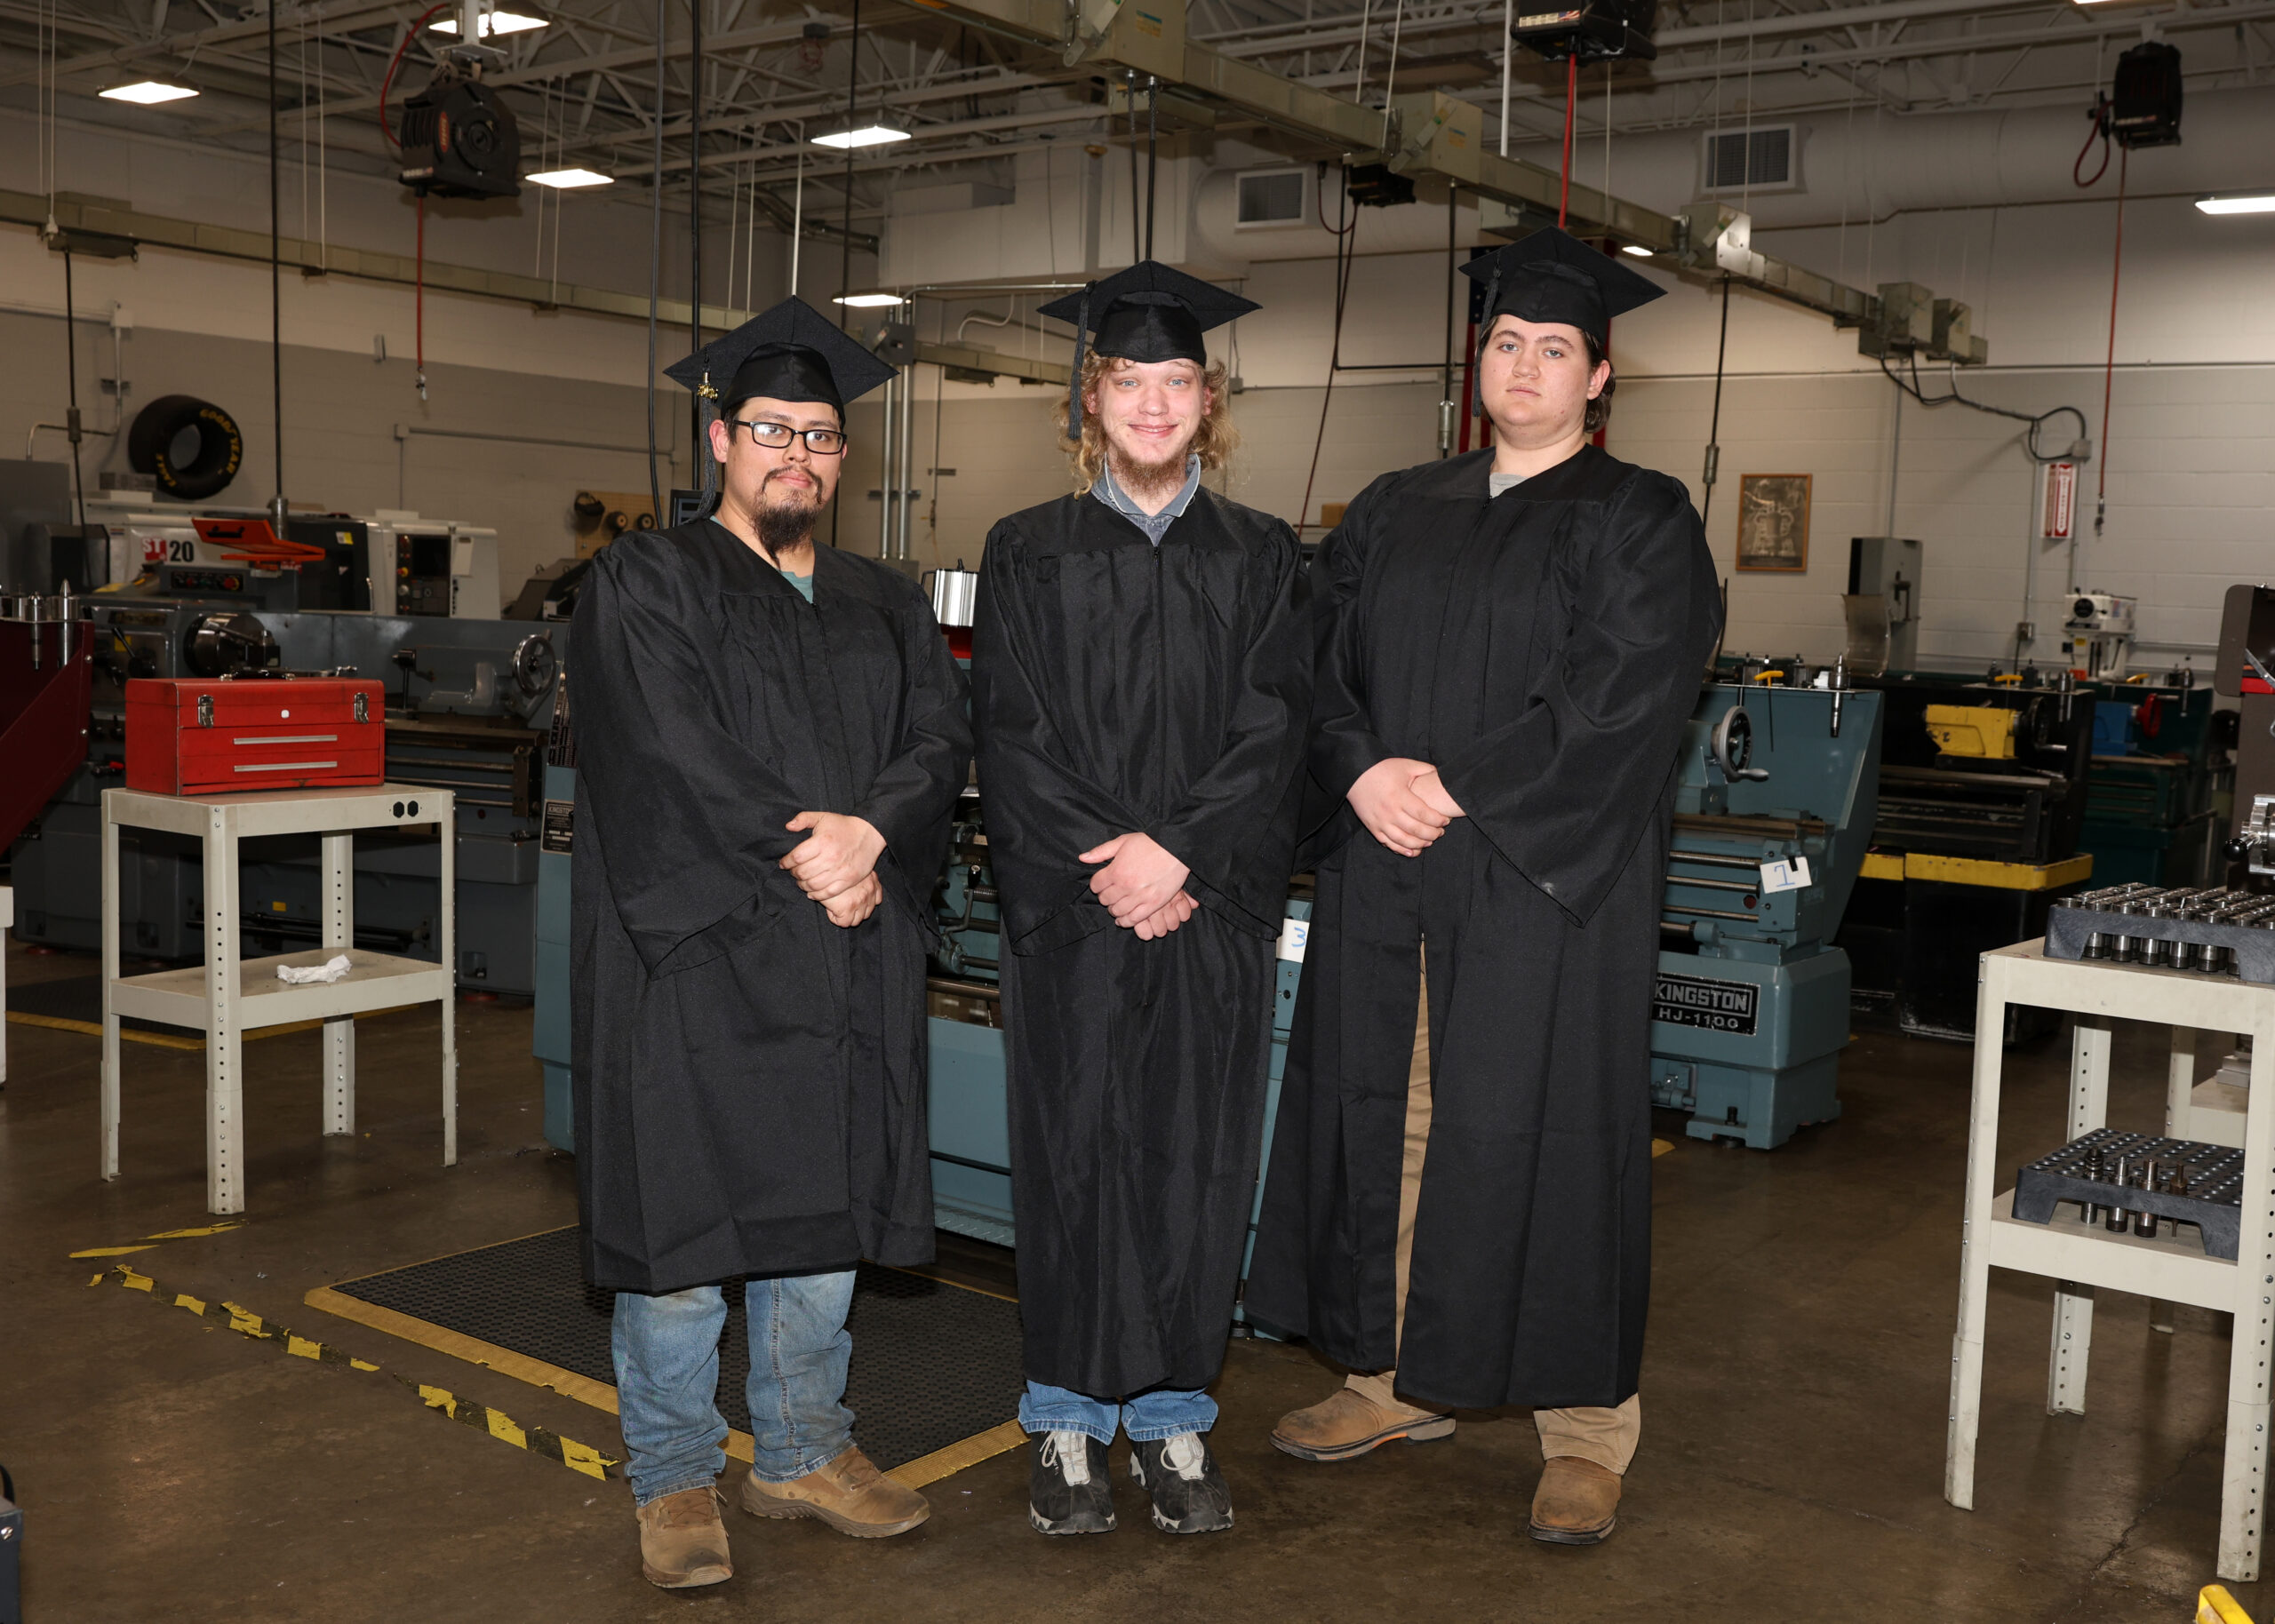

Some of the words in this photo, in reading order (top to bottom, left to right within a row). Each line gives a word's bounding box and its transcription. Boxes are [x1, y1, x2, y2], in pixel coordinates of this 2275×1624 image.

[142, 537, 165, 554] ST
[170, 539, 194, 562] 20
[1774, 864, 1796, 888] 1
[1291, 927, 1306, 948] 3
[1655, 981, 1748, 1013] KINGSTON
[1658, 1006, 1740, 1030] HJ-1100
